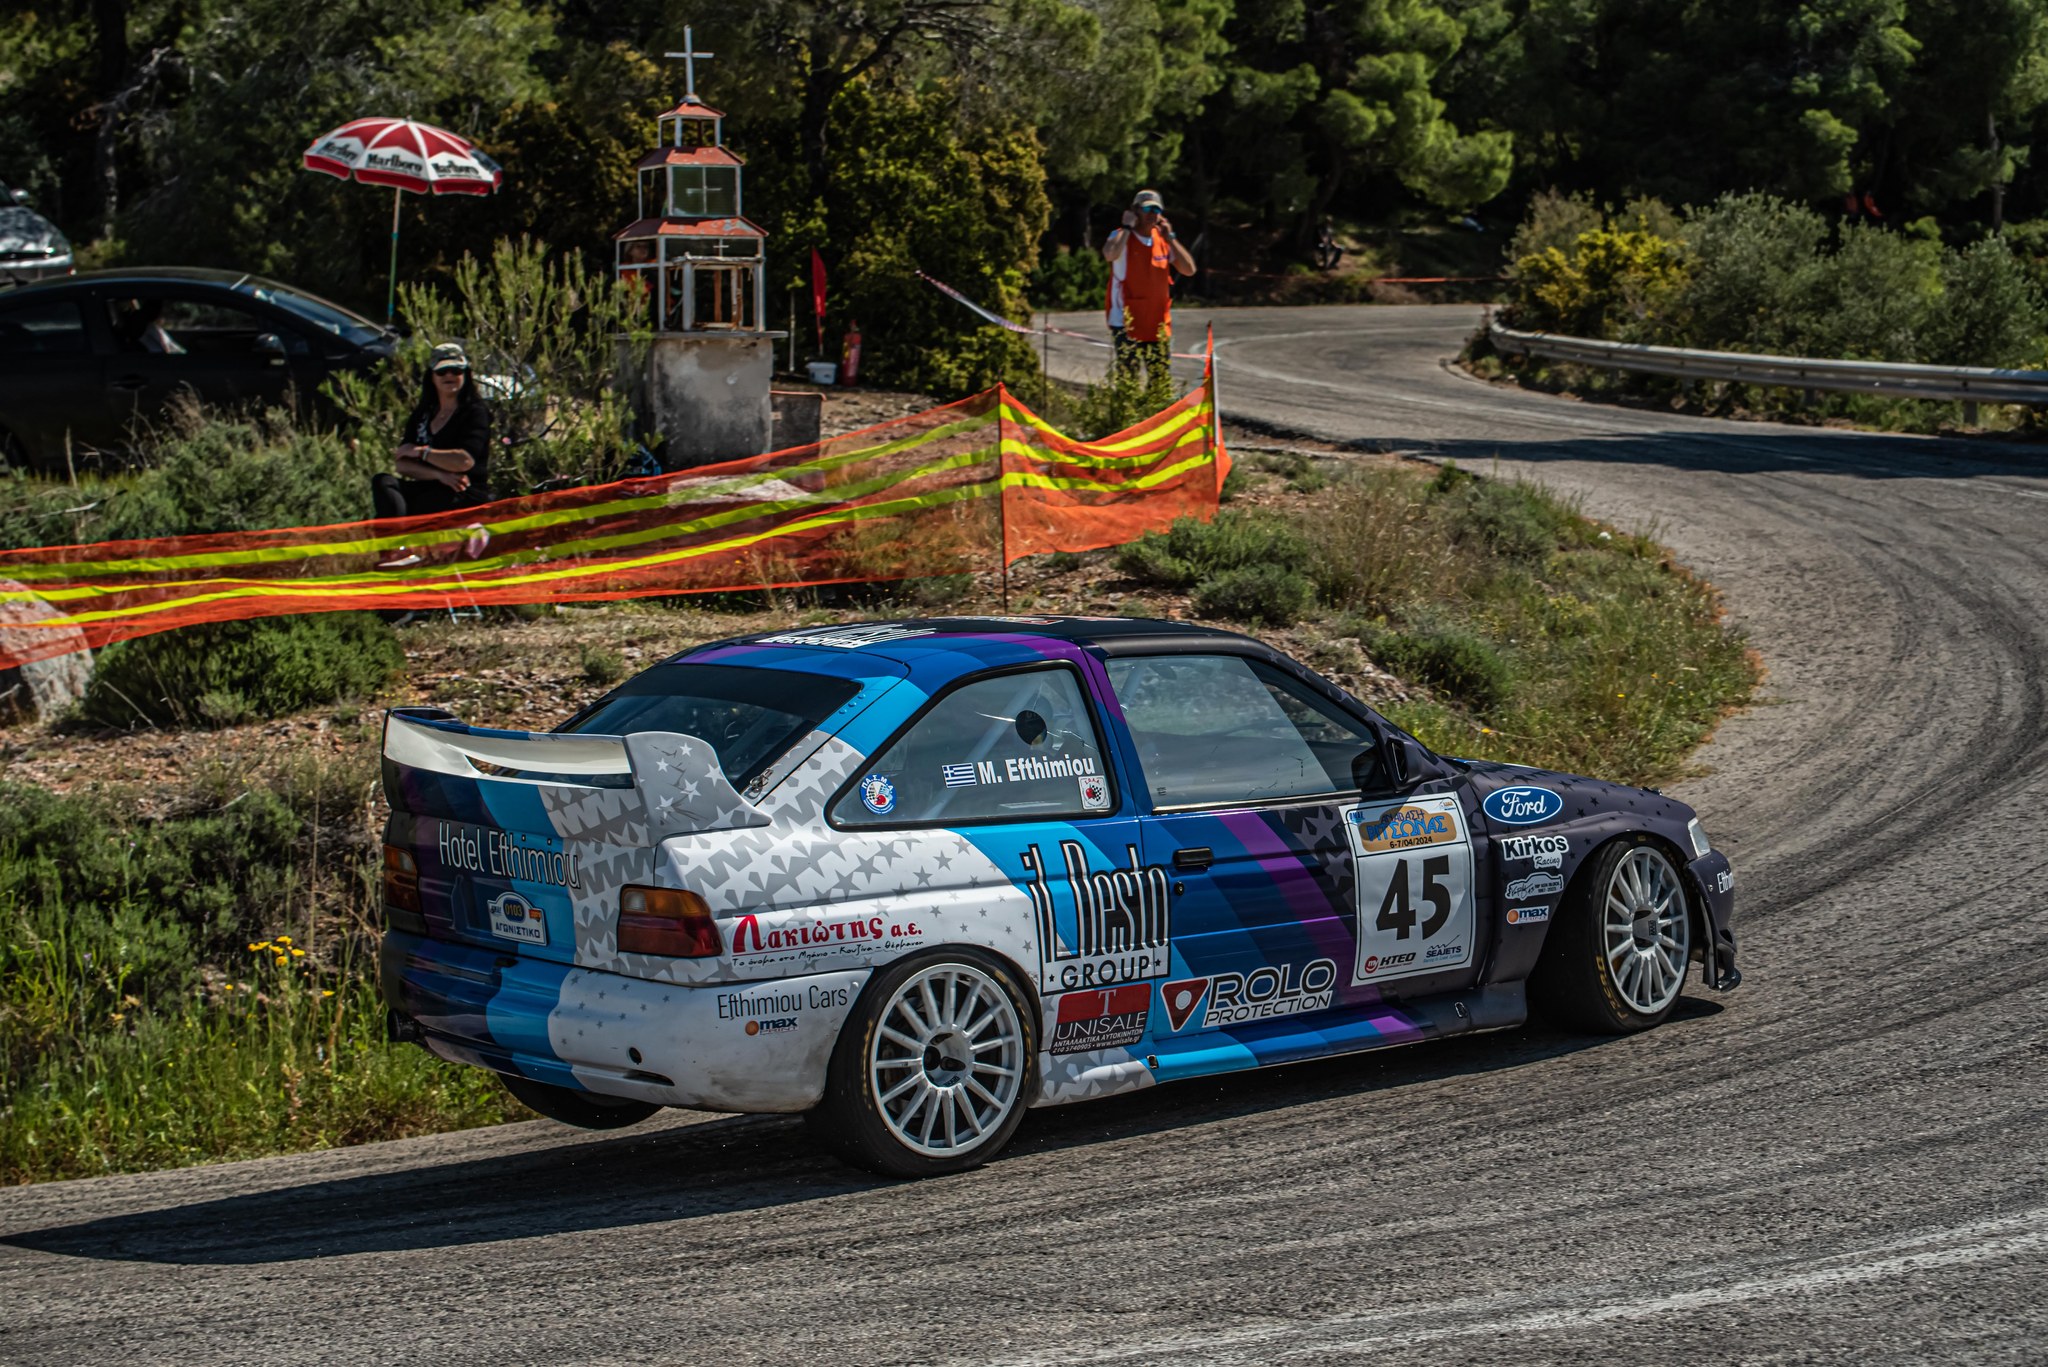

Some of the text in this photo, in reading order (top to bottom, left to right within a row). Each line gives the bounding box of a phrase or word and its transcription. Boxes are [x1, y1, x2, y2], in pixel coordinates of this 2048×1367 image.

[368, 153, 422, 171] Marlboro
[977, 754, 1096, 785] M. Efthimiou
[1501, 791, 1547, 818] Ford
[1366, 816, 1448, 842] ΡΙΤΣΩΝΑΣ
[439, 821, 581, 889] Hotel Efthimiou
[1390, 836, 1433, 849] 6-7/04/2024
[1503, 837, 1567, 859] Kirkos
[1535, 855, 1560, 866] Racing
[1376, 855, 1451, 940] 45
[1519, 908, 1547, 918] max
[495, 922, 541, 939] ΑΓΩΝΙΣΤΙΚΟ
[732, 914, 884, 954] Λακιώτης
[1426, 946, 1462, 958] SEAJETS
[1061, 955, 1150, 989] GROUP
[1208, 959, 1336, 1010] ROLO
[717, 985, 848, 1020] Efthimiou Cars
[1204, 992, 1331, 1026] PROTECTION
[760, 1017, 798, 1030] max
[1057, 1011, 1147, 1040] UNISALE
[1096, 1035, 1141, 1048] www.unisale.gr
